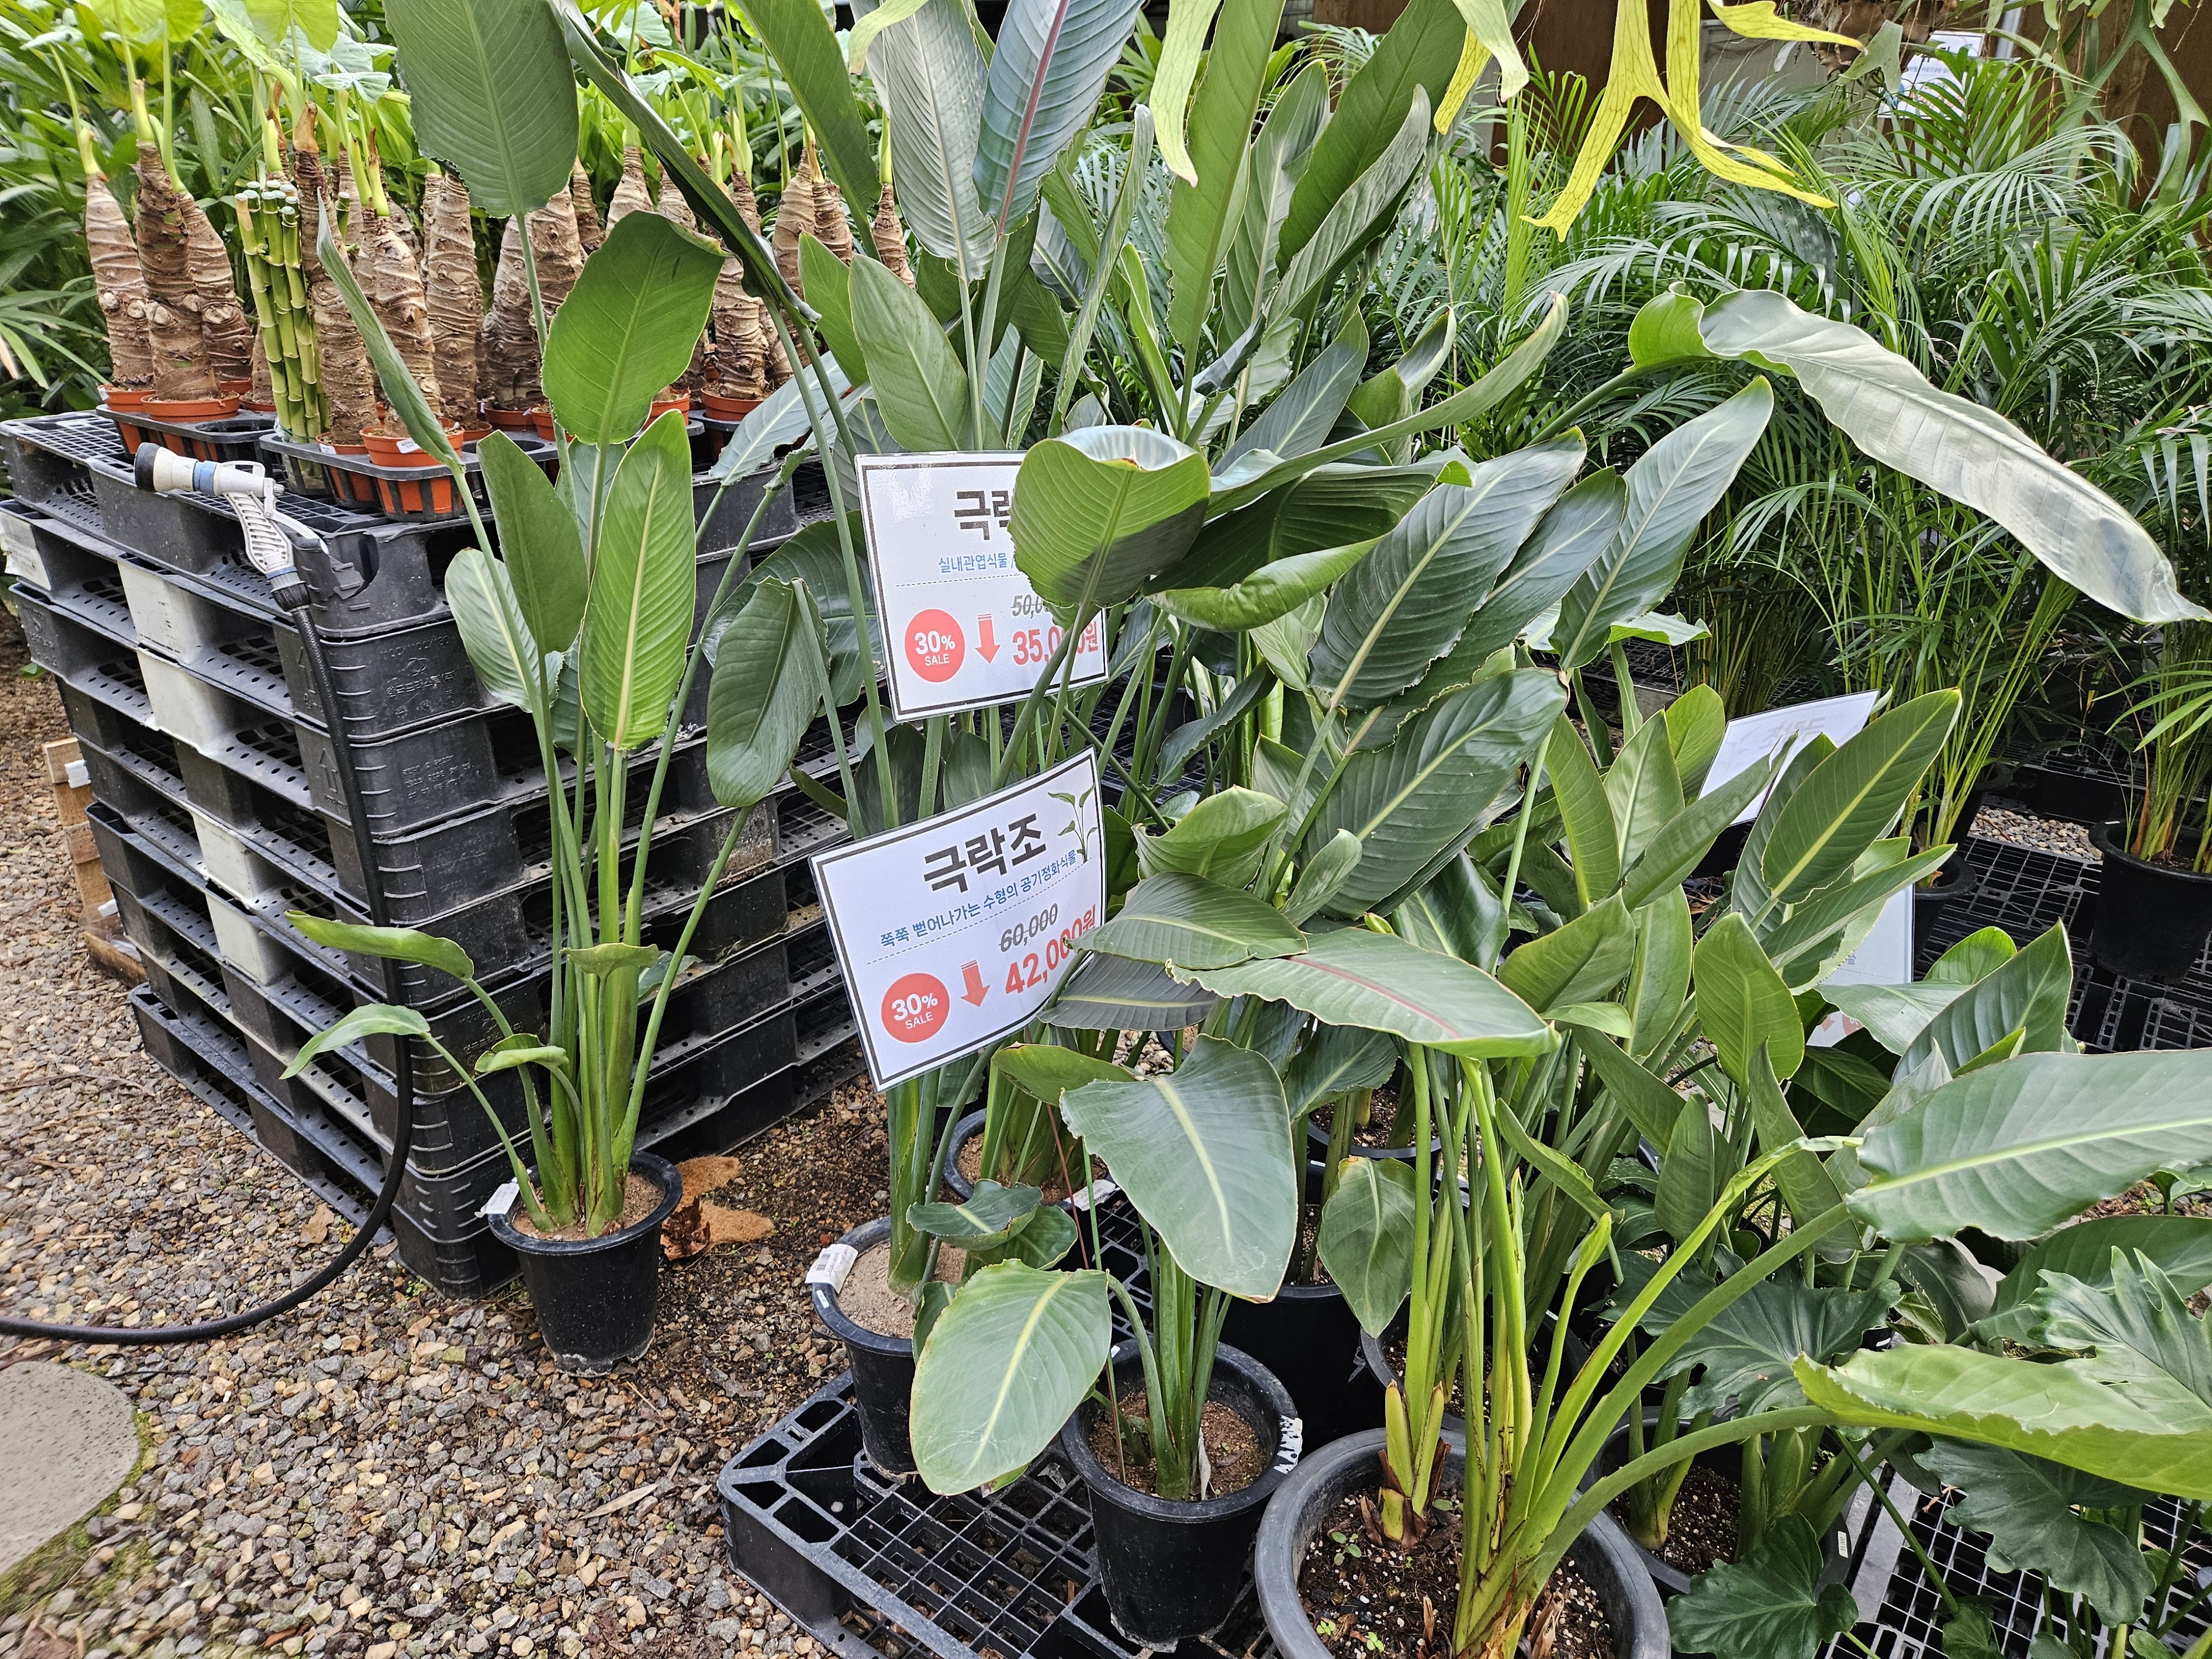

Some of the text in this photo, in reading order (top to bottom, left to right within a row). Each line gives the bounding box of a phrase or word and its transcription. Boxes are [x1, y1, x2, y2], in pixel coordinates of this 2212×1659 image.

[938, 552, 1008, 573] 실내관엽식물
[1011, 594, 1048, 619] 50,0
[914, 630, 956, 655] 30%
[925, 653, 950, 666] SALE
[924, 813, 1047, 893] 극락조
[880, 849, 1077, 947] 쭉쭉 뻗어나가는 수형의 공기정화식물
[998, 902, 1058, 952] 60,000
[891, 993, 938, 1021] 30%
[905, 1011, 933, 1029] SALE
